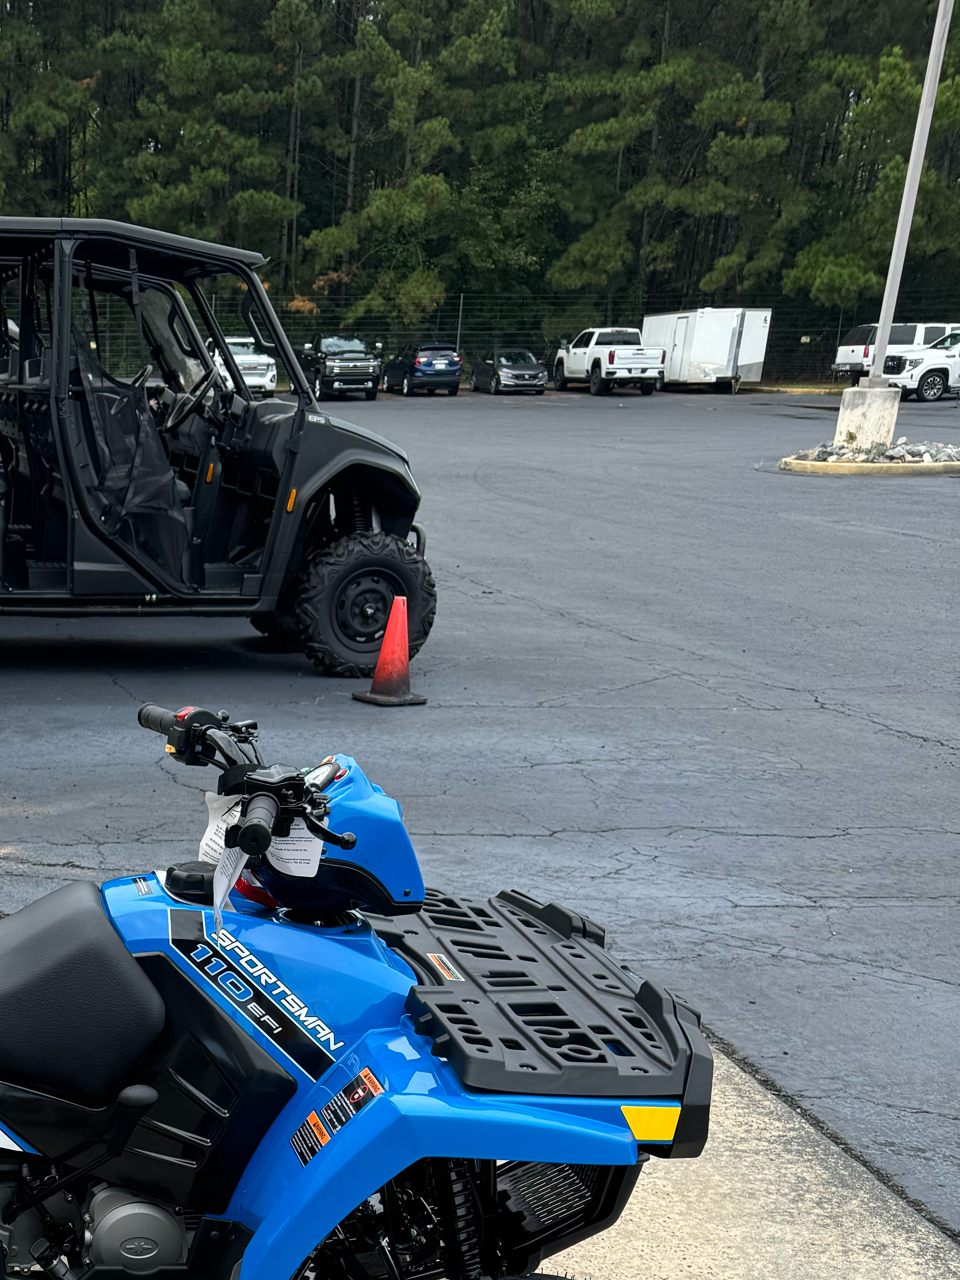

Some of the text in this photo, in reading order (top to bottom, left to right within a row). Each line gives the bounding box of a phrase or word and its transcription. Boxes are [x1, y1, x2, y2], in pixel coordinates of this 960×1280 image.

[189, 943, 254, 1003] 110
[246, 1003, 283, 1034] EFI
[211, 928, 346, 1052] SPORTSMAN
